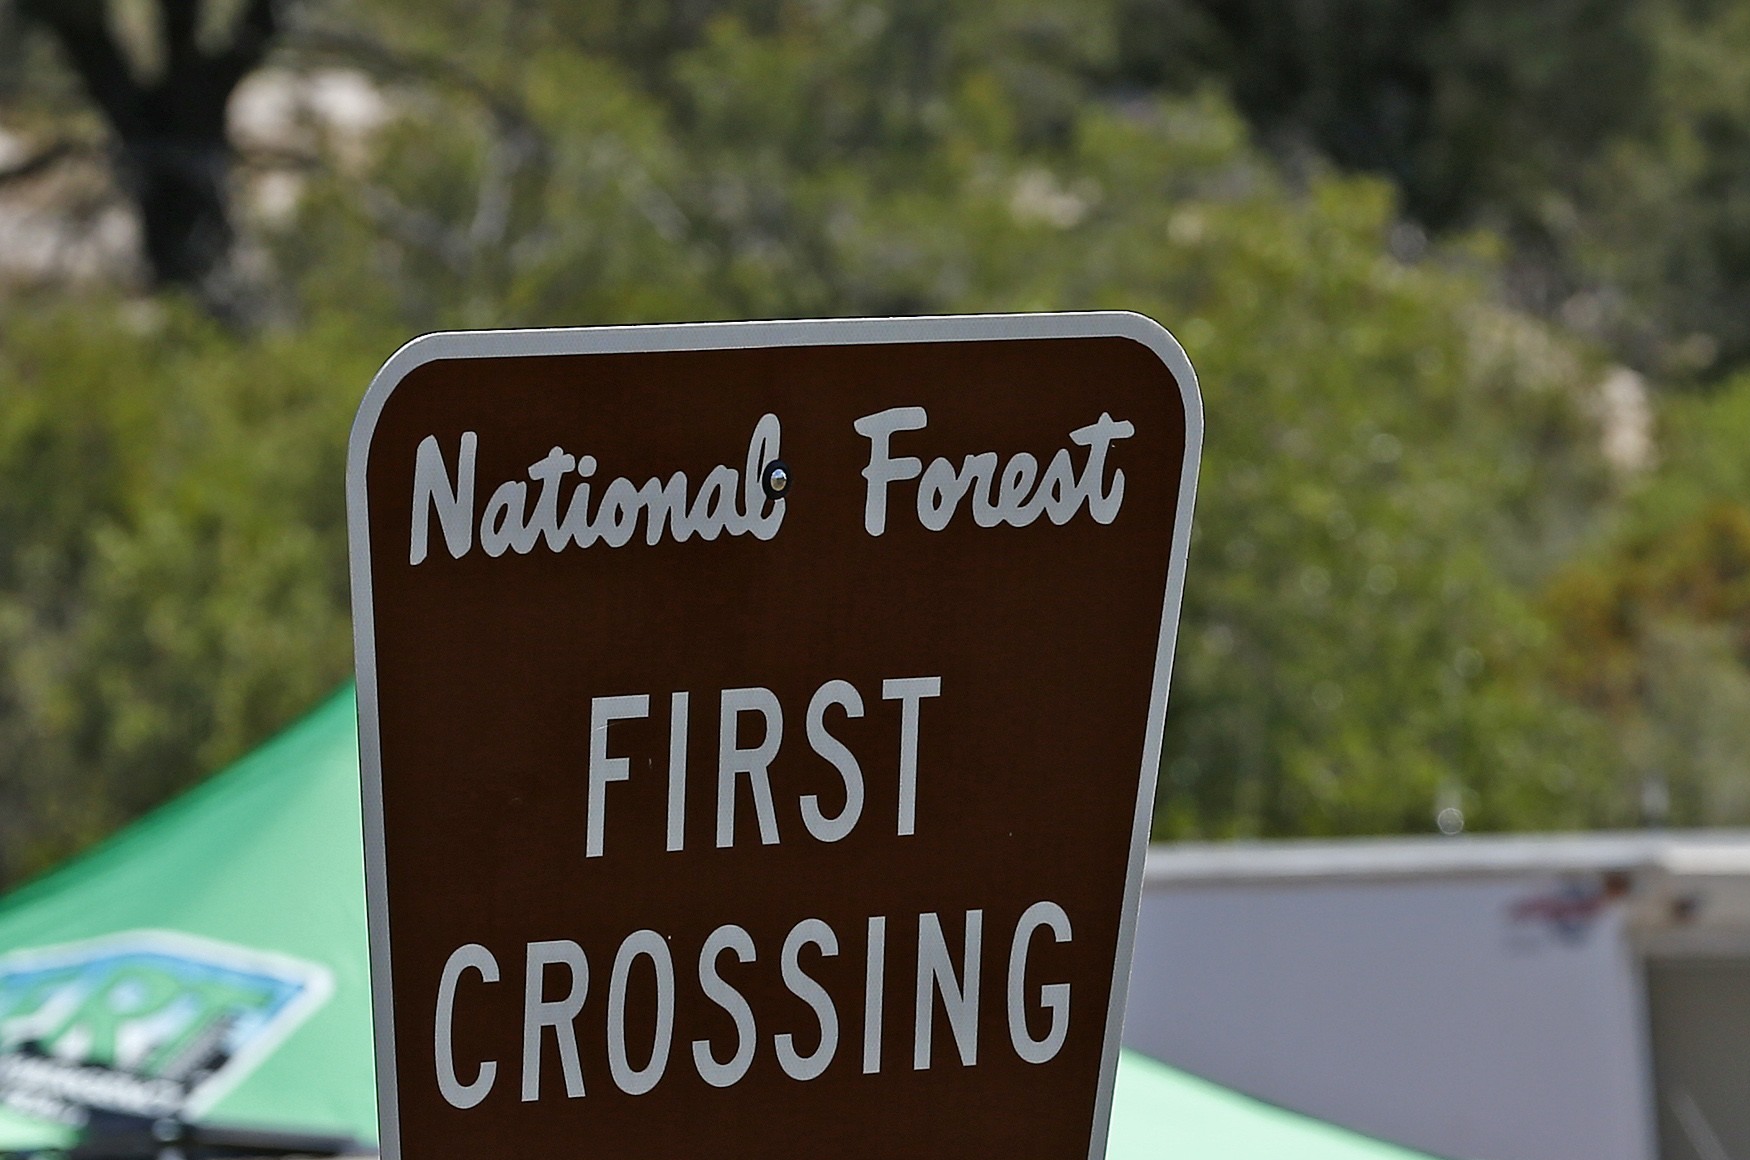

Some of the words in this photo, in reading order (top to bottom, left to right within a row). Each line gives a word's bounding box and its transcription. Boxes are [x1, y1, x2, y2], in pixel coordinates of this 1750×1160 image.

[409, 412, 788, 566] National
[852, 406, 1136, 538] Forest
[585, 676, 942, 859] FIRST
[434, 900, 1073, 1110] CROSSING
